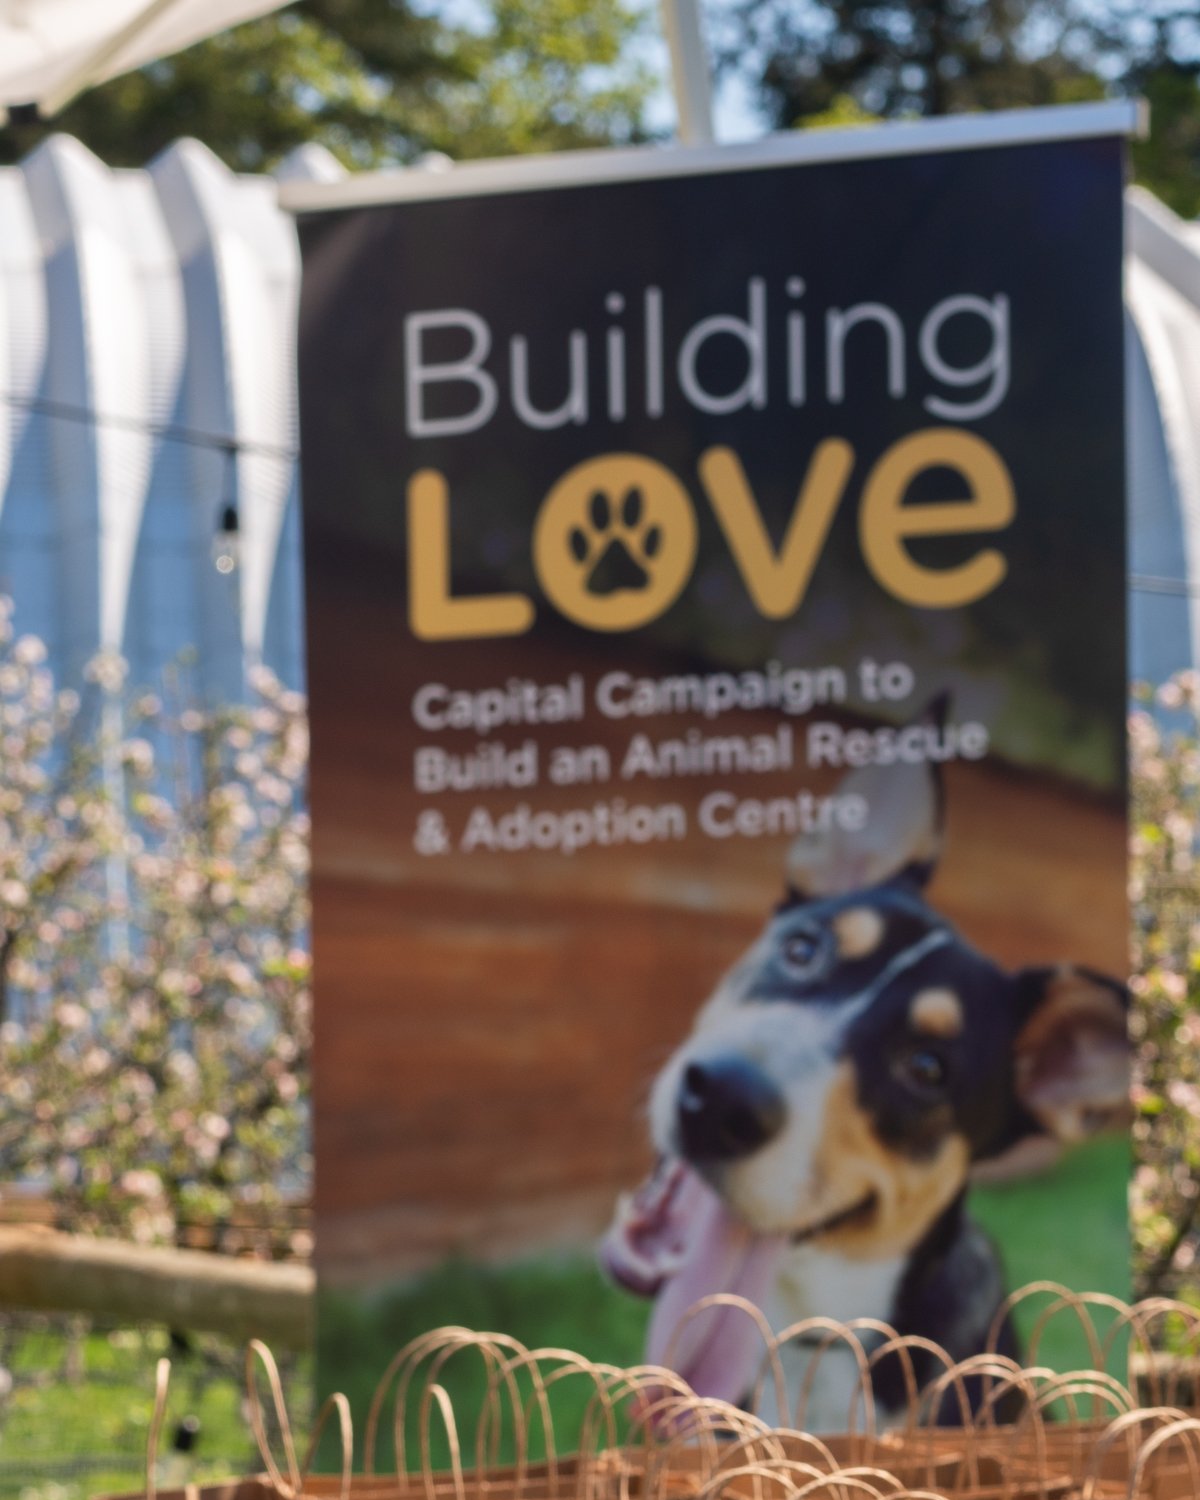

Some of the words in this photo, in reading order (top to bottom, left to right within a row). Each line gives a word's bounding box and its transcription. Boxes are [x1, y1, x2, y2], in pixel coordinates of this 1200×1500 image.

[404, 276, 1013, 438] Building
[411, 671, 586, 736] Capital
[596, 658, 847, 720] Campaign
[858, 655, 915, 702] to
[414, 738, 539, 793] Build
[550, 744, 612, 786] an
[620, 721, 794, 781] Animal
[807, 719, 989, 768] Rescue
[413, 808, 449, 856] &
[460, 796, 688, 856] Adoption
[697, 788, 869, 839] Centre
